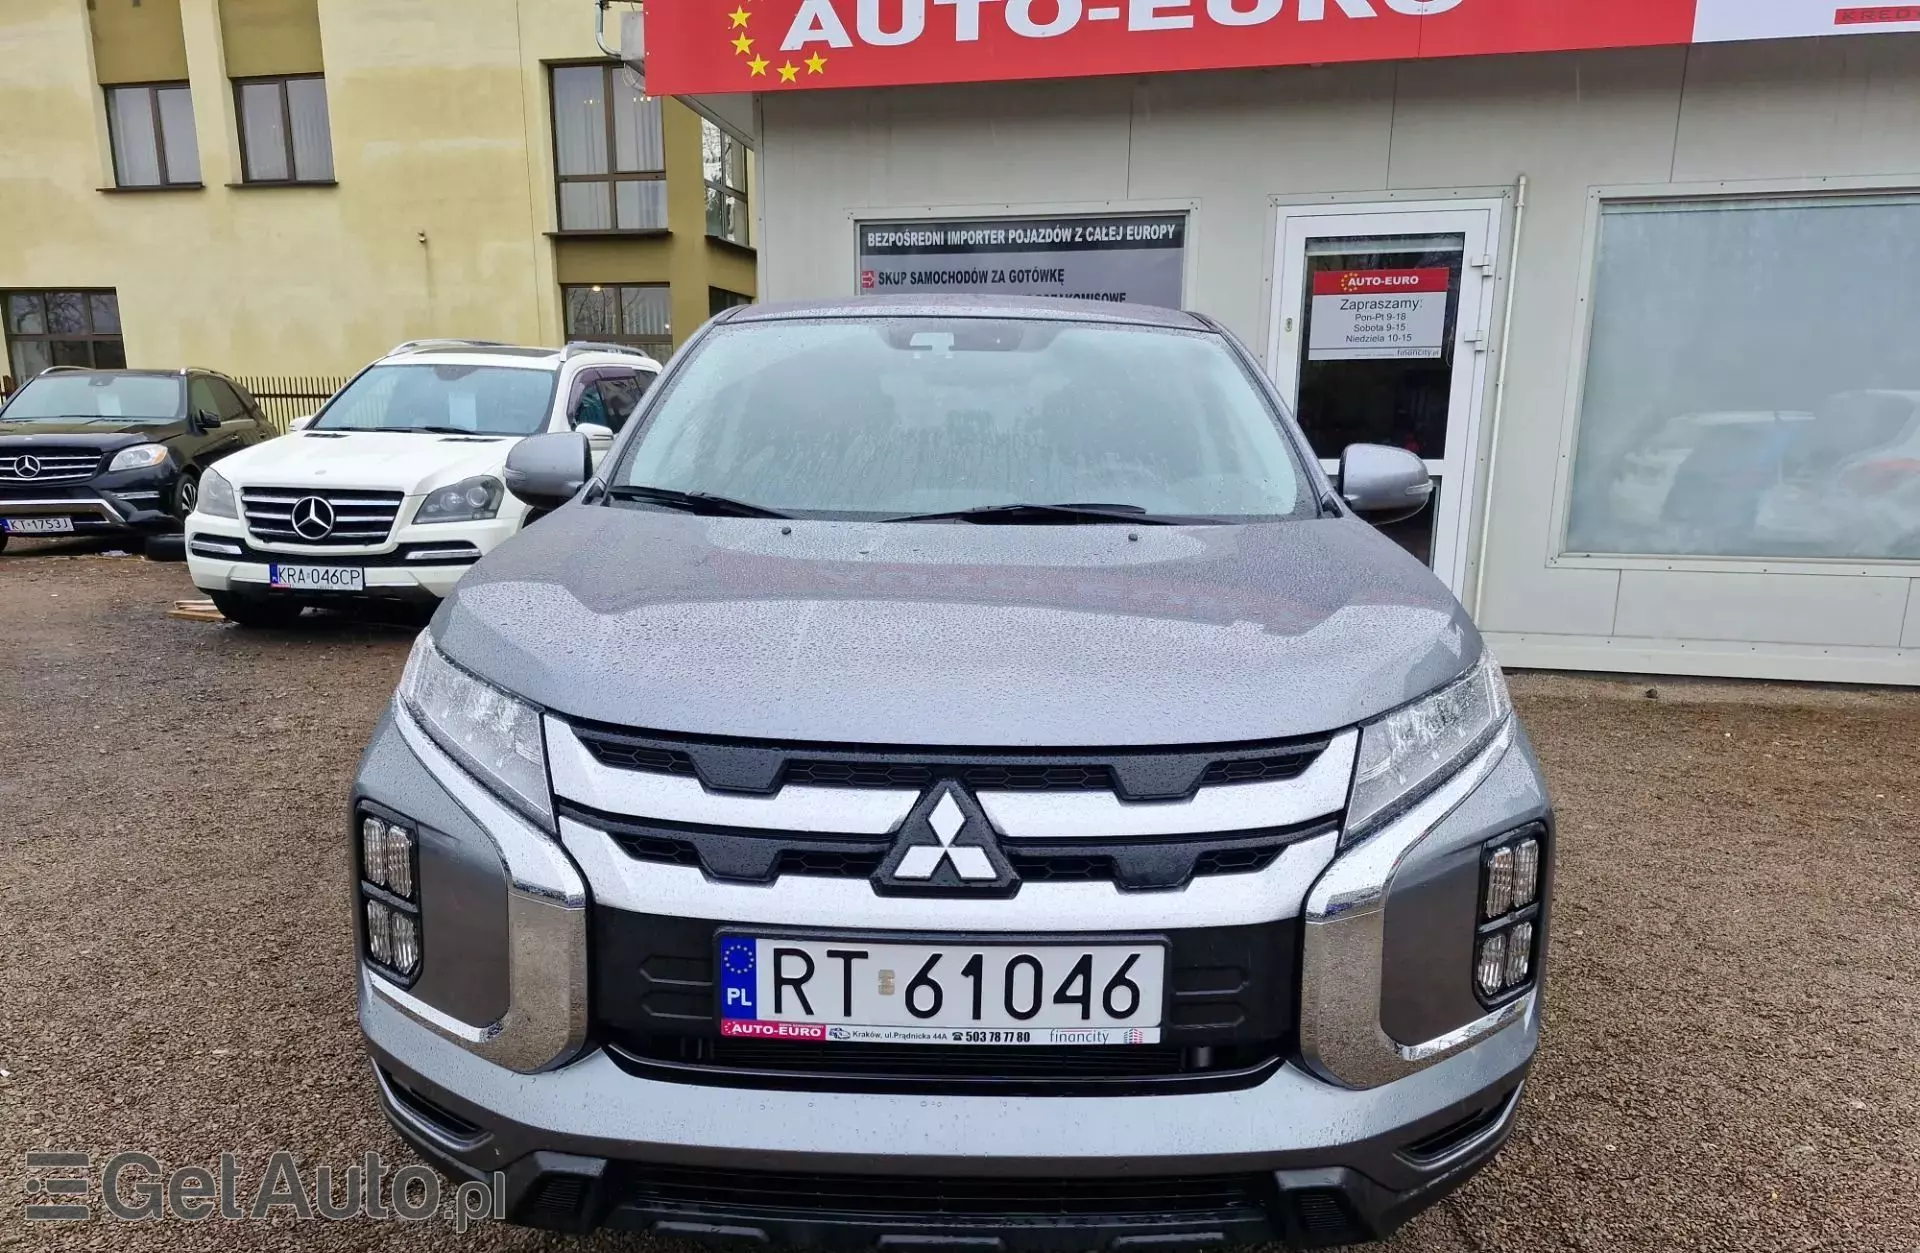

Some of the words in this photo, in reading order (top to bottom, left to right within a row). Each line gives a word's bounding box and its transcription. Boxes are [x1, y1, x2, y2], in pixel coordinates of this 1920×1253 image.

[867, 229, 944, 247] BEZPOŚREDNI
[947, 230, 1005, 246] IMPORTER
[1008, 225, 1072, 244] POJAZDÓW
[1074, 227, 1083, 242] Z
[1085, 226, 1123, 241] CAŁEJ
[1126, 224, 1176, 240] EUROPY
[878, 271, 907, 285] SKUP
[910, 267, 988, 285] SAMOCHODÓW
[991, 270, 1006, 283] ZA
[1009, 266, 1065, 286] GOTÓWKĘ
[1348, 276, 1419, 286] AUTO-EURO
[1340, 299, 1423, 312] Zapraszamy:
[1355, 313, 1384, 321] Pon-Pt
[1386, 312, 1406, 321] 9-18
[1353, 324, 1384, 332] Sobota
[1386, 323, 1406, 331] 9-15
[1345, 335, 1385, 343] Niedziela
[1388, 333, 1412, 342] 10-15
[279, 567, 306, 584] KRA
[311, 568, 360, 585] 046CP
[773, 947, 869, 1017] RT
[905, 953, 1141, 1021] 61046
[727, 987, 752, 1006] PL
[732, 1024, 821, 1037] AUTO-EURO
[852, 1029, 883, 1039] Kraków,
[966, 1031, 987, 1043] 503
[989, 1031, 1001, 1043] 78
[1003, 1031, 1014, 1043] 77
[1017, 1031, 1030, 1043] 80
[1050, 1028, 1110, 1045] financity
